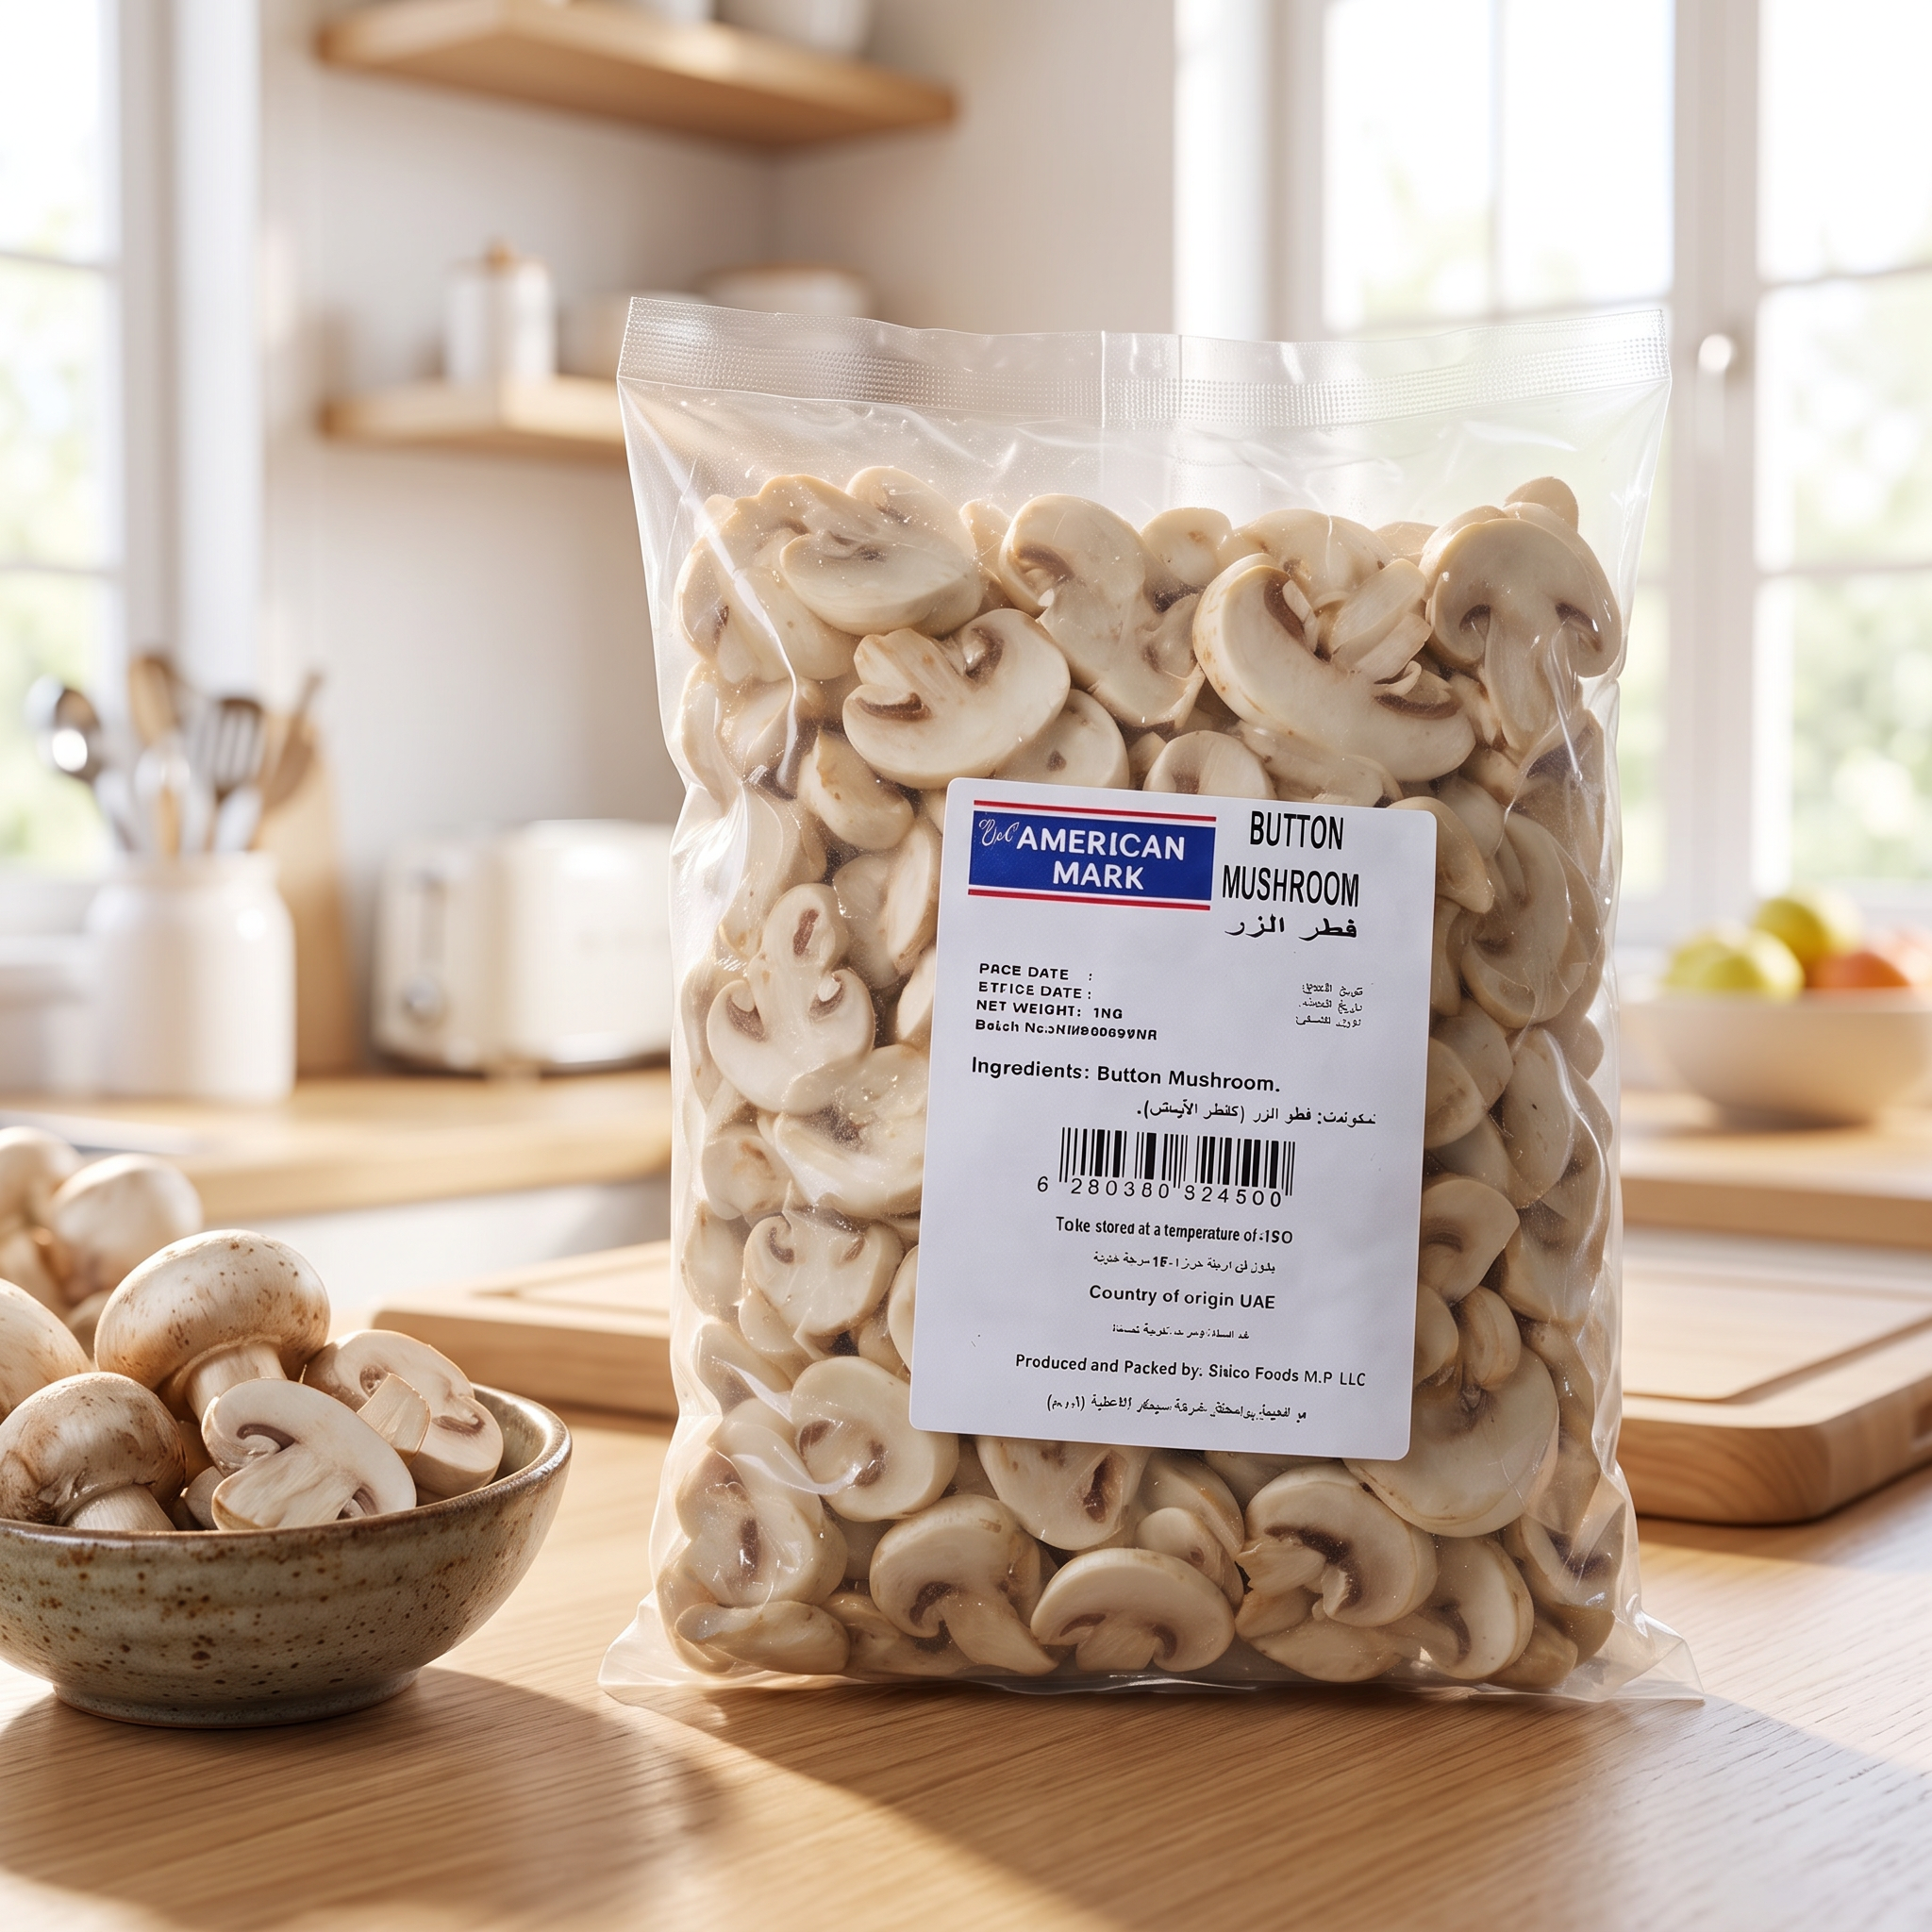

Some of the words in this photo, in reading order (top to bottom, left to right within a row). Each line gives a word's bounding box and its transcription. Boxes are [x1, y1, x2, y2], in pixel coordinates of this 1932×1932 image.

[1016, 824, 1185, 860] AMERICAN
[1249, 810, 1344, 851] BUTTON
[1052, 860, 1144, 891] MARK
[1222, 864, 1359, 908] MUSHROOM
[1224, 913, 1285, 939] الزر
[1298, 917, 1357, 941] فطر
[979, 962, 1022, 976] PACE
[1027, 966, 1069, 981] DATE
[1041, 985, 1082, 999] DATE
[976, 999, 1008, 1012] NET
[1012, 1002, 1081, 1018] WEIGHT:
[972, 1056, 1090, 1079] Ingredients:
[1097, 1065, 1161, 1085] Button
[1168, 1070, 1280, 1092] Mushroom.
[1252, 1107, 1279, 1124] الزر
[1037, 1175, 1049, 1192] 6
[1070, 1180, 1169, 1200] 280380
[1095, 1220, 1135, 1235] stored
[1138, 1222, 1151, 1236] at
[1153, 1224, 1161, 1237] a
[1163, 1224, 1241, 1243] temperature
[1089, 1284, 1158, 1307] Country
[1162, 1289, 1180, 1303] of
[1184, 1291, 1234, 1310] origin
[1240, 1293, 1275, 1309] UAE
[1015, 1354, 1088, 1372] Produced
[1091, 1358, 1119, 1373] and
[1124, 1359, 1177, 1375] Packed
[1255, 1366, 1299, 1382] Foods
[1304, 1370, 1333, 1384] M.P
[1340, 1372, 1366, 1387] LLC
